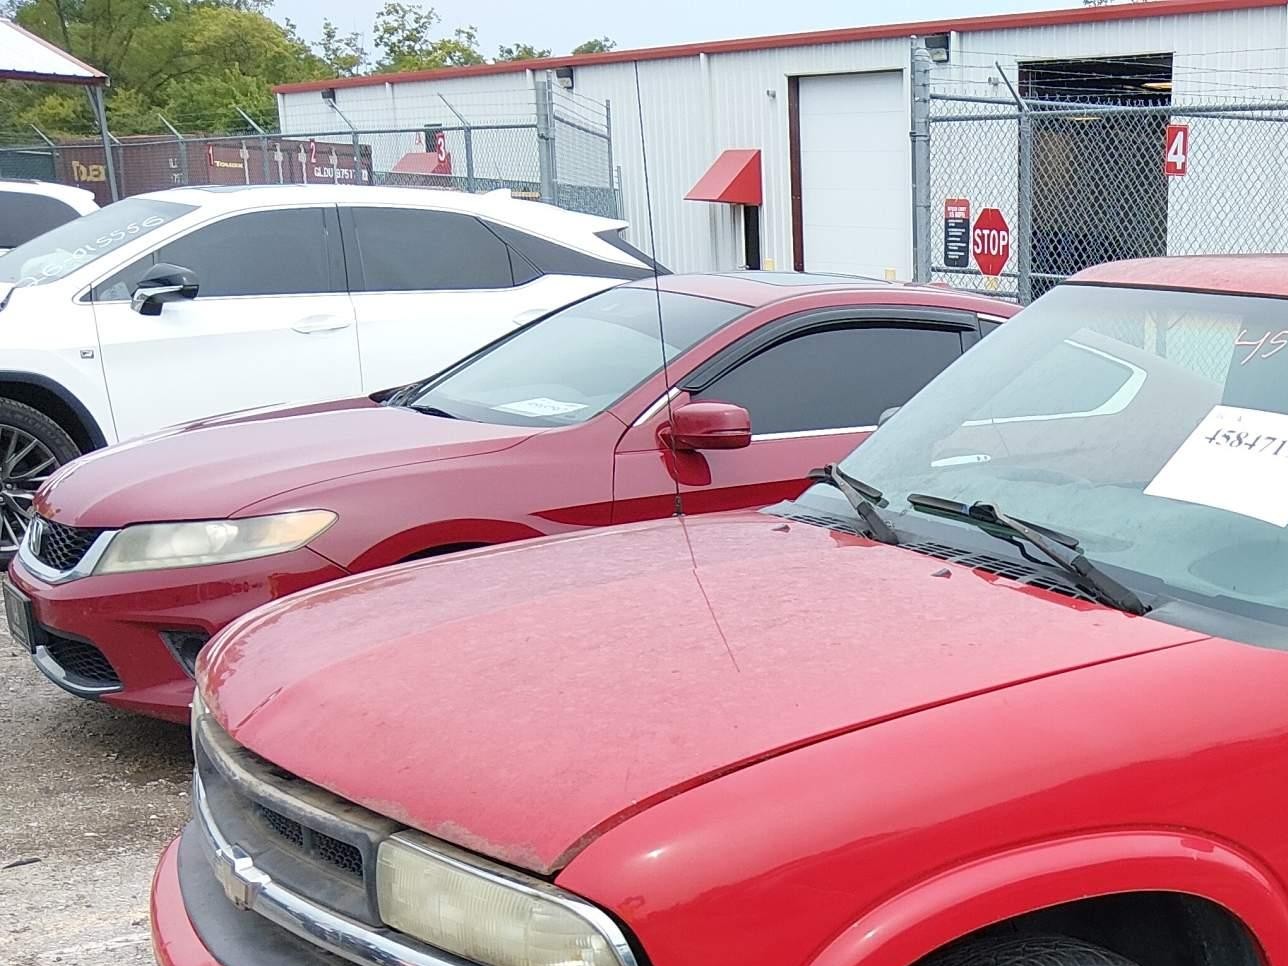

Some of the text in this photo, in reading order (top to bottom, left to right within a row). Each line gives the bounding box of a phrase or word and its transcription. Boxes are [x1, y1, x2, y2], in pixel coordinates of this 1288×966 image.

[437, 136, 446, 162] 3
[1167, 131, 1186, 170] 4
[973, 228, 1009, 257] STOP
